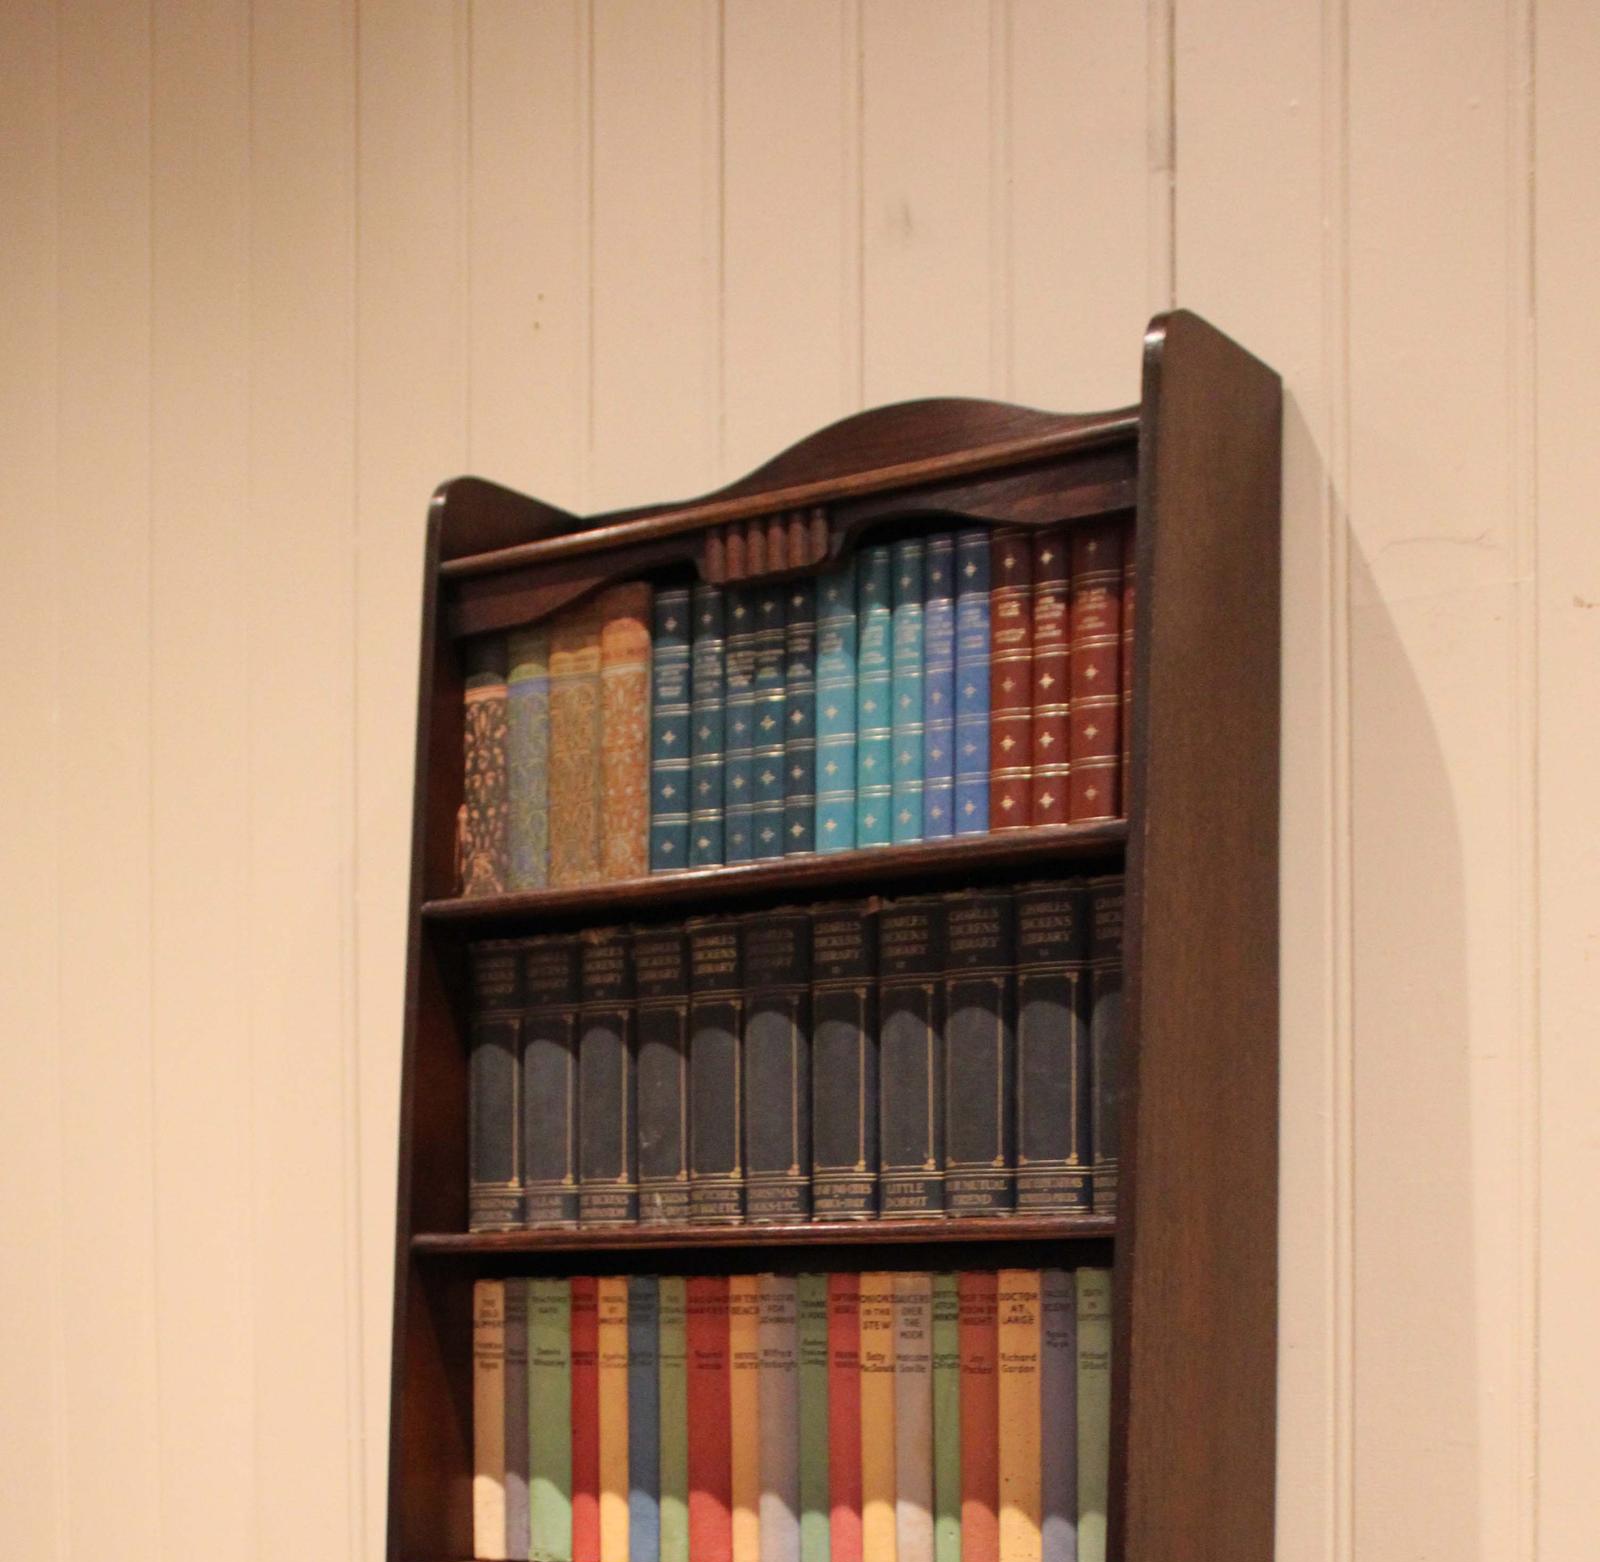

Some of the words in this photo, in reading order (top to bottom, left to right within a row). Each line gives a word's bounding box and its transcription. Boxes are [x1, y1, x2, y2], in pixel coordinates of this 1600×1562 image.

[900, 1306, 924, 1316] OVER
[1010, 1303, 1024, 1314] AT
[862, 1320, 891, 1330] STEW
[903, 1318, 920, 1328] THE
[1003, 1315, 1035, 1325] LARGE
[1001, 1352, 1037, 1362] Richard
[1002, 1363, 1036, 1373] Gordon
